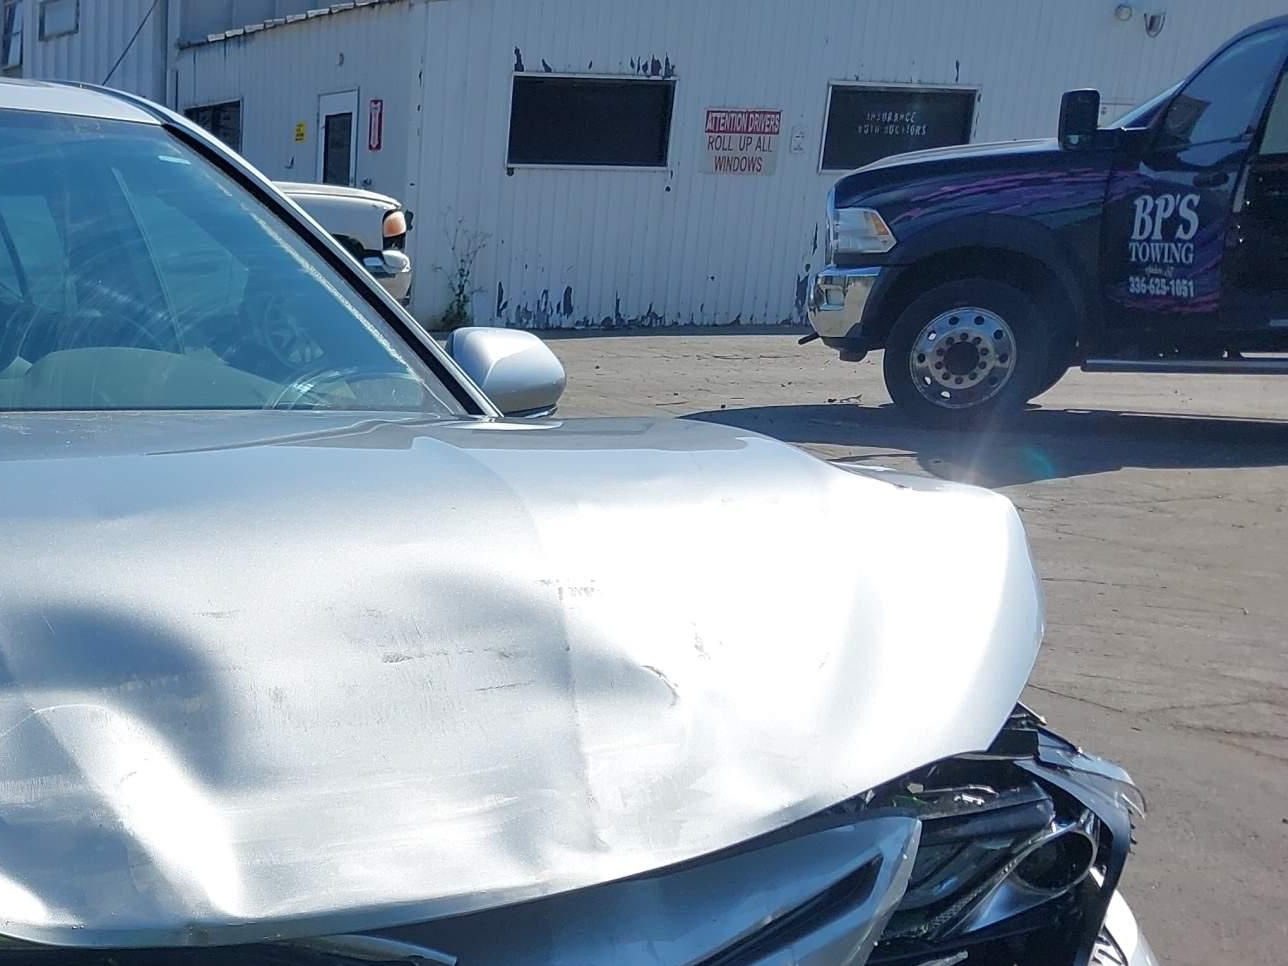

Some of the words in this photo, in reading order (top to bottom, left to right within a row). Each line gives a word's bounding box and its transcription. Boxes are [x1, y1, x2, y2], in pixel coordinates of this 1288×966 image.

[706, 112, 746, 132] ATTENTION
[748, 112, 779, 133] DRIVERS
[708, 135, 733, 151] ROLL
[738, 135, 752, 152] UP
[755, 136, 772, 152] ALL
[714, 155, 763, 172] WINDOWS
[1131, 194, 1201, 240] BP'S
[1129, 242, 1194, 264] TOWING
